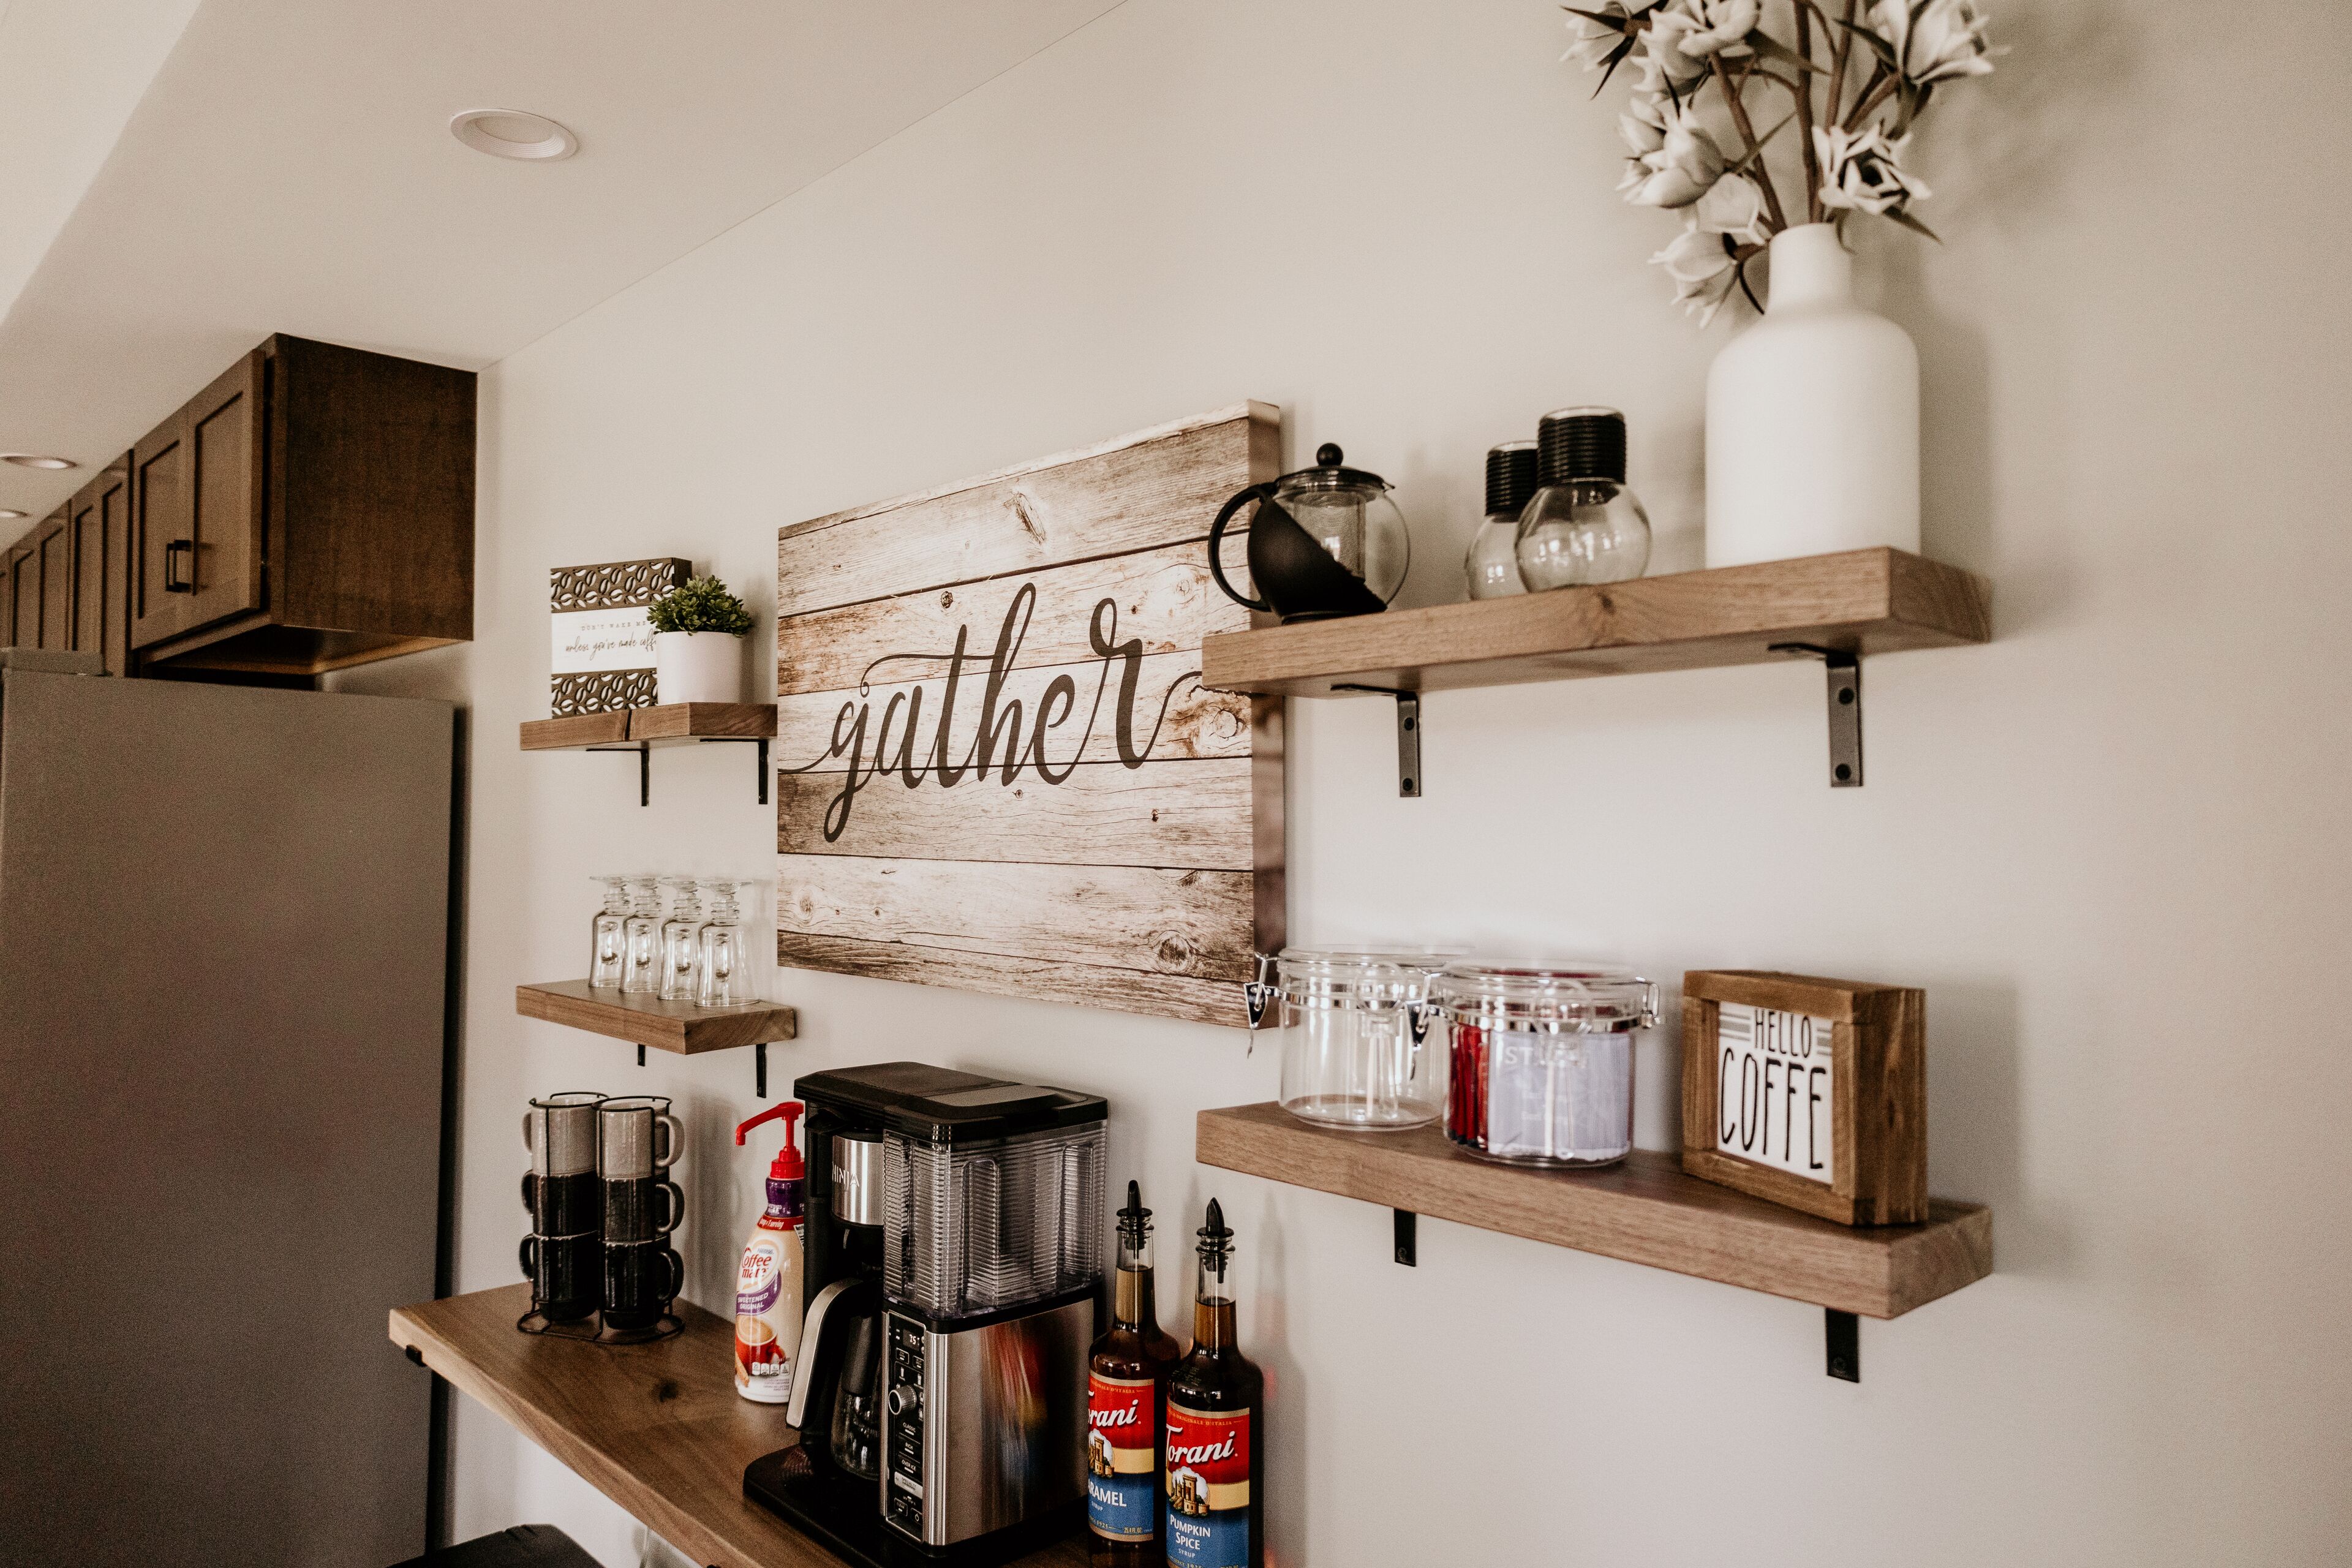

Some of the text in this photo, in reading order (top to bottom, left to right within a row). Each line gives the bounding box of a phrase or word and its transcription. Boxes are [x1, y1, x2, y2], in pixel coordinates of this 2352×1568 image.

[778, 582, 1202, 843] gather
[1755, 1008, 1812, 1058] HELLO
[1721, 1047, 1826, 1169] COFFE
[832, 1161, 860, 1191] NINJA
[741, 1246, 772, 1268] Coffee
[737, 1292, 769, 1303] SWEETENED
[1088, 1390, 1139, 1427] rani
[1166, 1423, 1235, 1466] Torani
[1088, 1479, 1127, 1507] ARAMEL
[1170, 1513, 1211, 1537] PUMPKIN
[1175, 1532, 1200, 1550] SPICE
[1178, 1548, 1196, 1558] SYRUP
